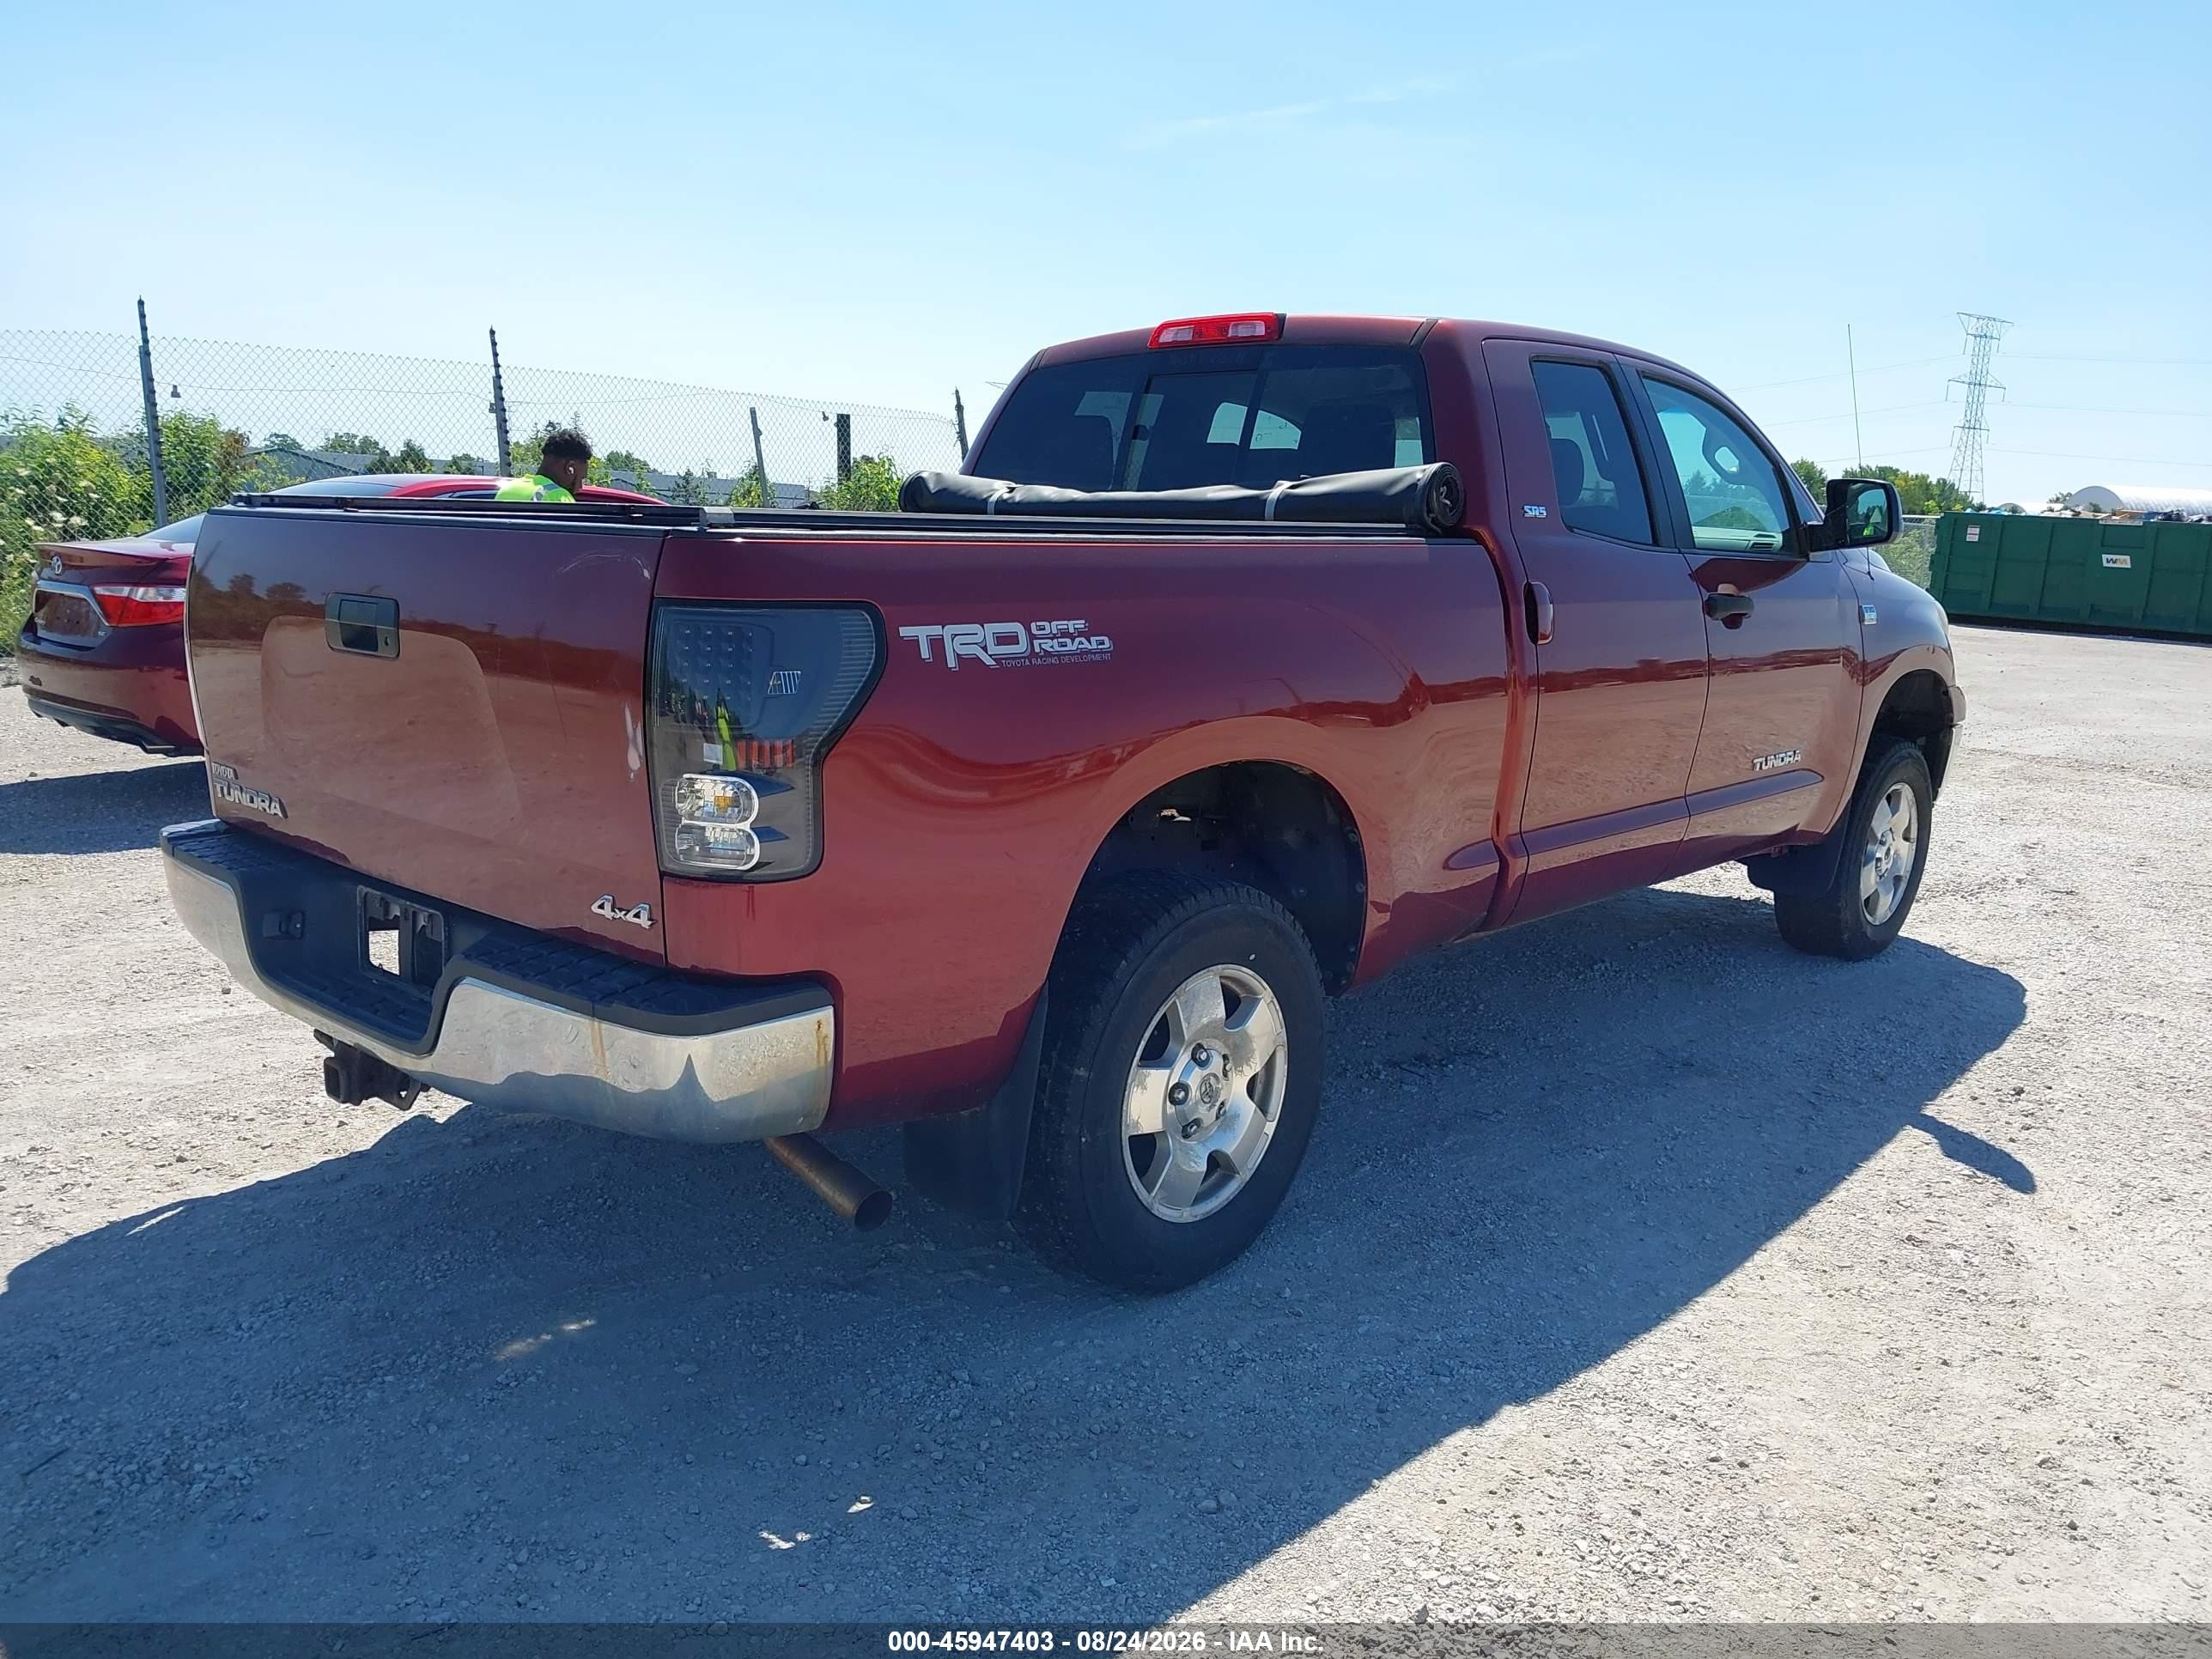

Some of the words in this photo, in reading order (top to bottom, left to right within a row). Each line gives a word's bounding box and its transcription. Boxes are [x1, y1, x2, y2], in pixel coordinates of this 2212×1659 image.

[1523, 505, 1547, 518] SR5
[1030, 619, 1088, 636] OFF
[898, 622, 1030, 671] TRD
[1033, 635, 1113, 654] ROAD
[1001, 658, 1030, 668] TOYOTA
[1031, 656, 1060, 666] RACING
[1060, 653, 1112, 664] DEVELOPMENT
[1753, 749, 1802, 771] TUNDRA
[213, 780, 285, 819] TUNDRA
[591, 894, 654, 929] 4x4
